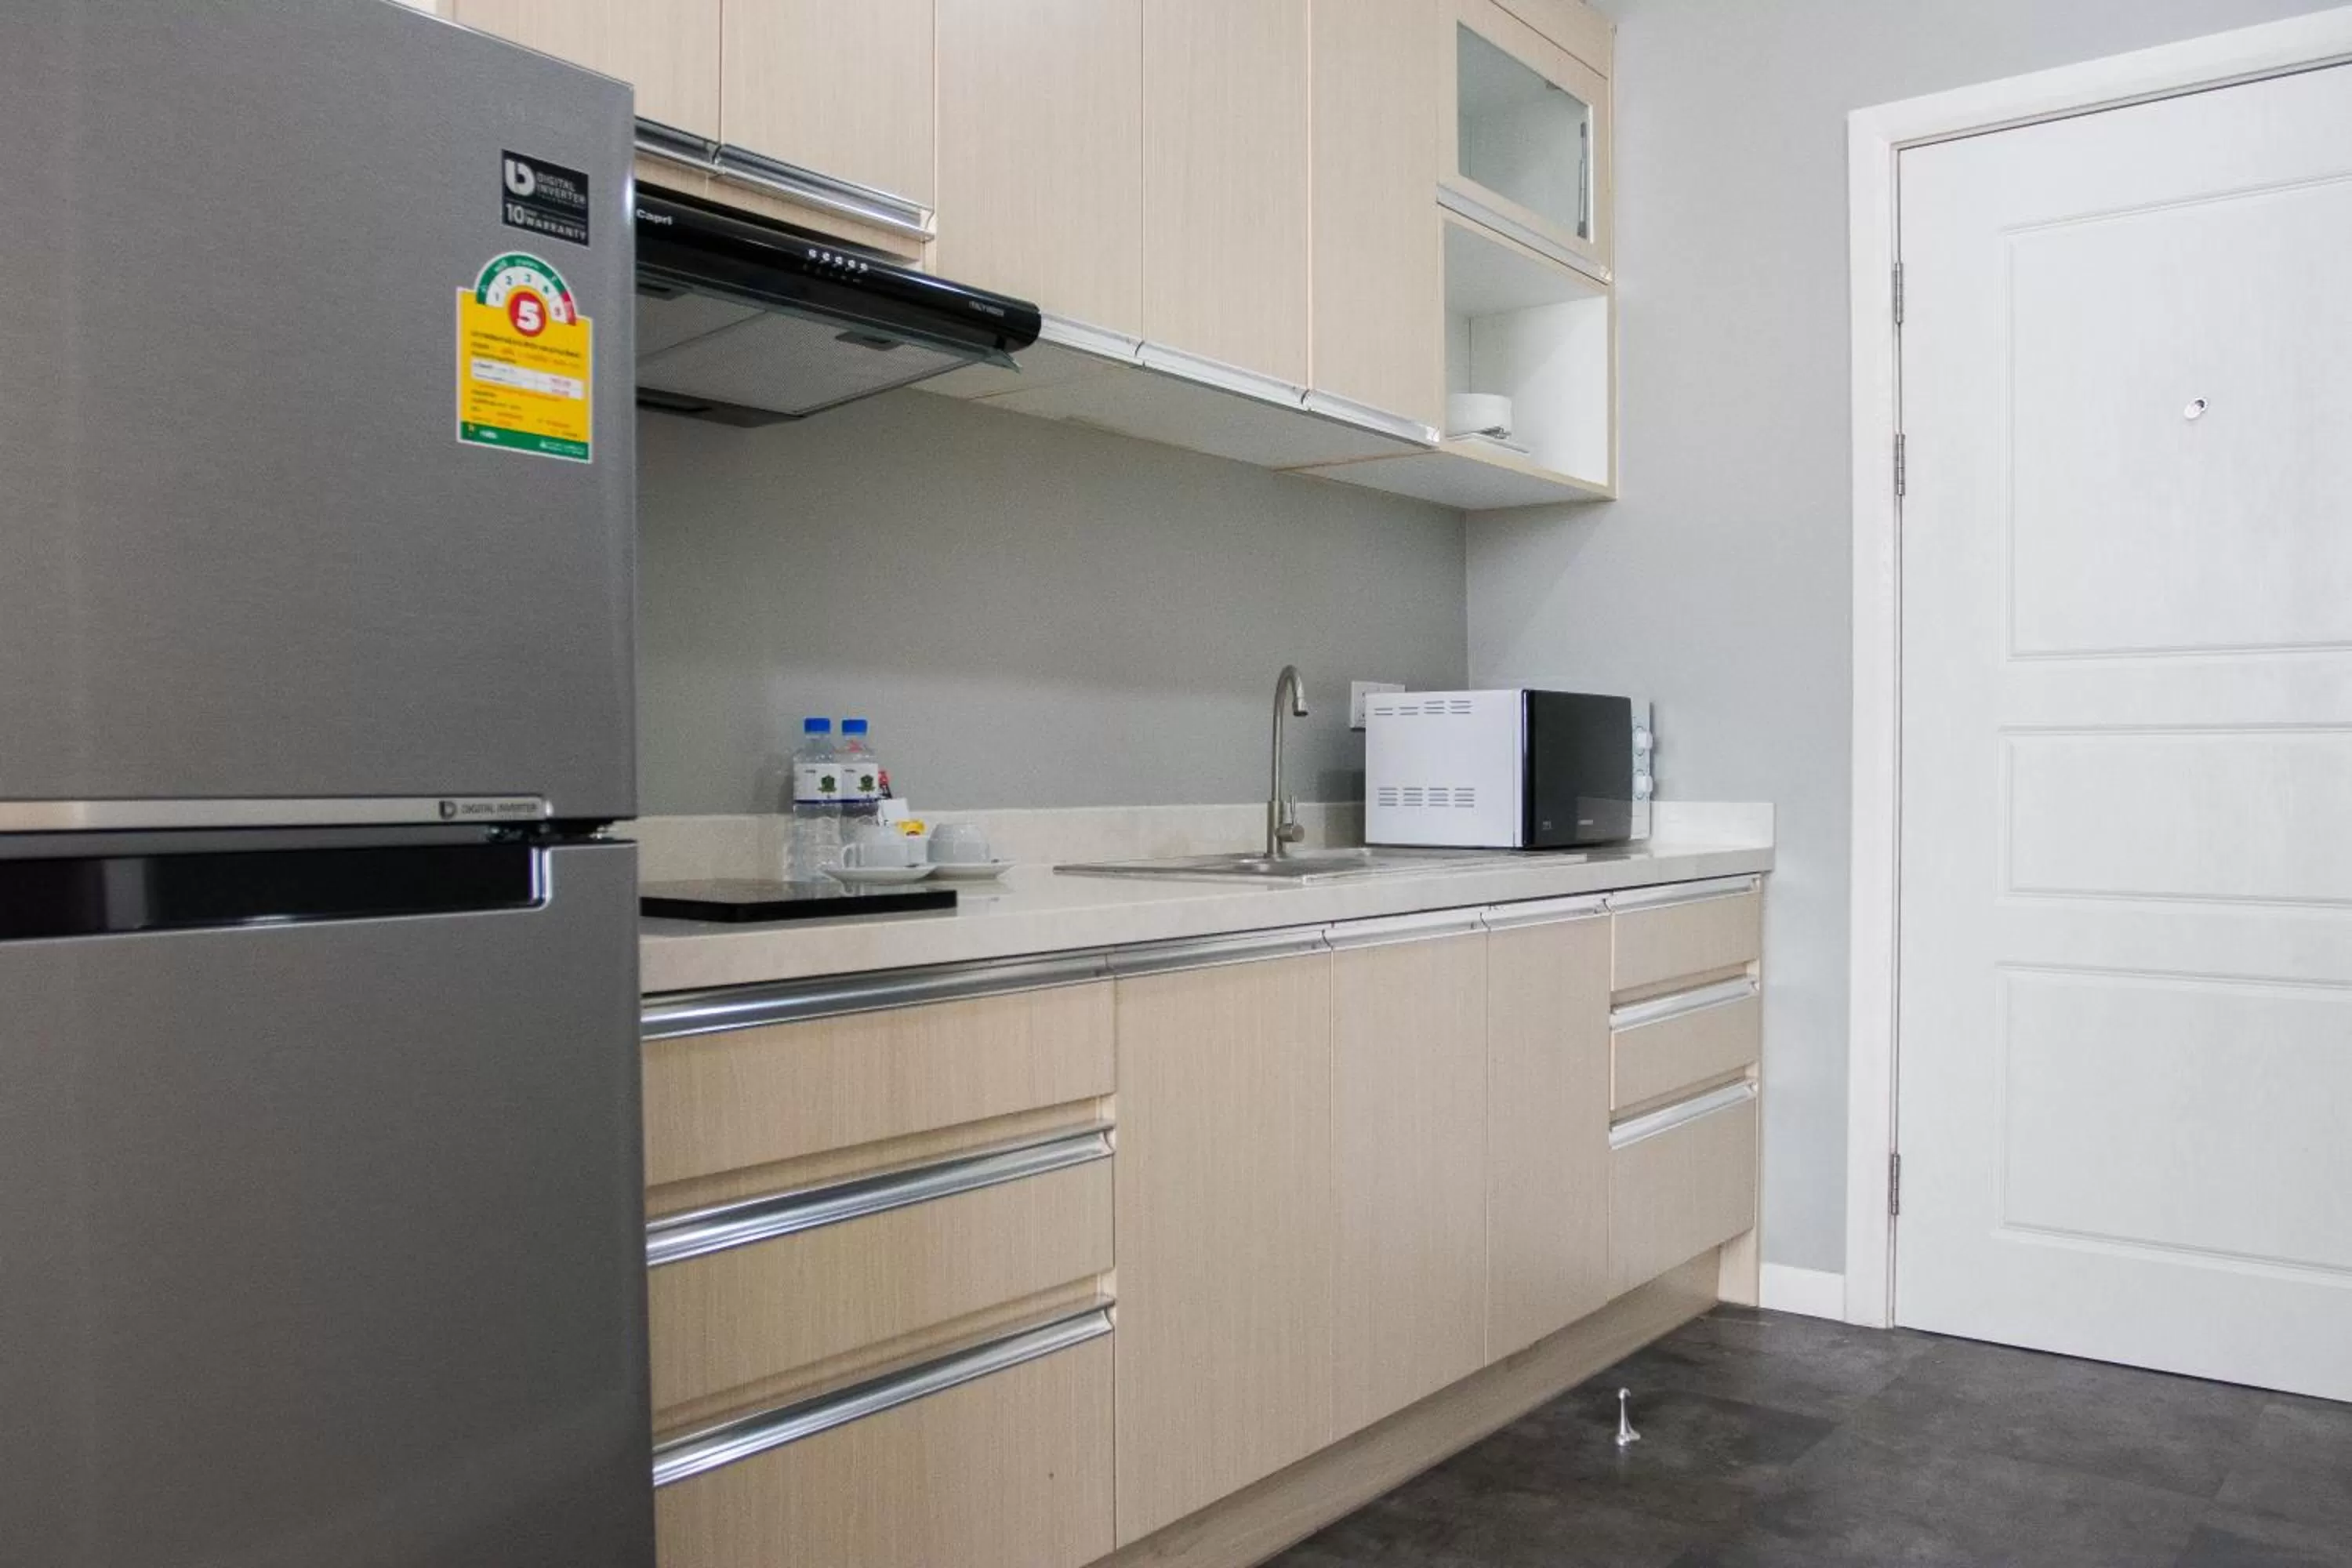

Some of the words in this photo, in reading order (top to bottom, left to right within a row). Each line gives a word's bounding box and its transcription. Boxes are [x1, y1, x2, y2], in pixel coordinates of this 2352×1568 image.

[536, 172, 575, 191] DIGITAL
[536, 184, 586, 204] INVERTER
[506, 203, 524, 224] 10
[636, 209, 673, 226] Capri
[527, 217, 586, 240] WARRANTY
[517, 300, 540, 330] 5
